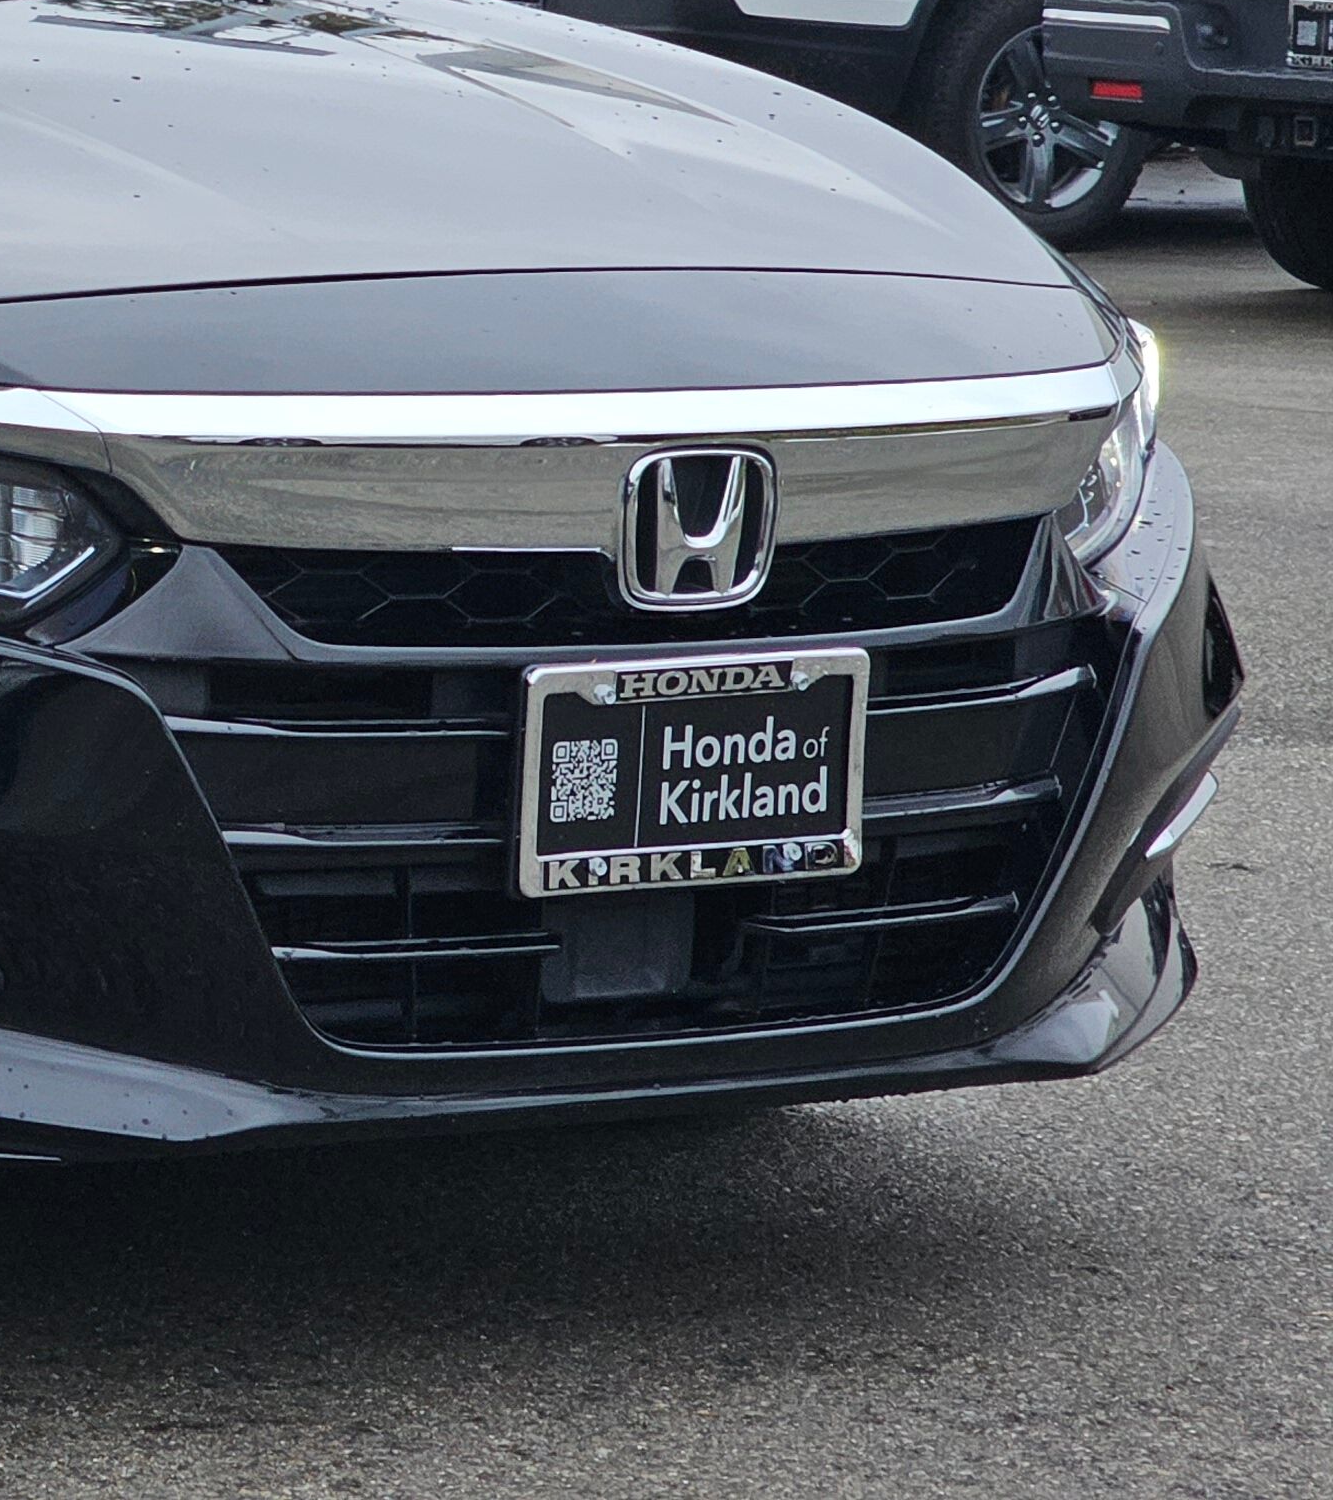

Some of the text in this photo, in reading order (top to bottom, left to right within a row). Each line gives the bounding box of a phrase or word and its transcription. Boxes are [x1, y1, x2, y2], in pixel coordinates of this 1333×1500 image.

[619, 664, 785, 699] HONDA
[662, 715, 830, 770] Honda of
[659, 766, 829, 826] Kirkland
